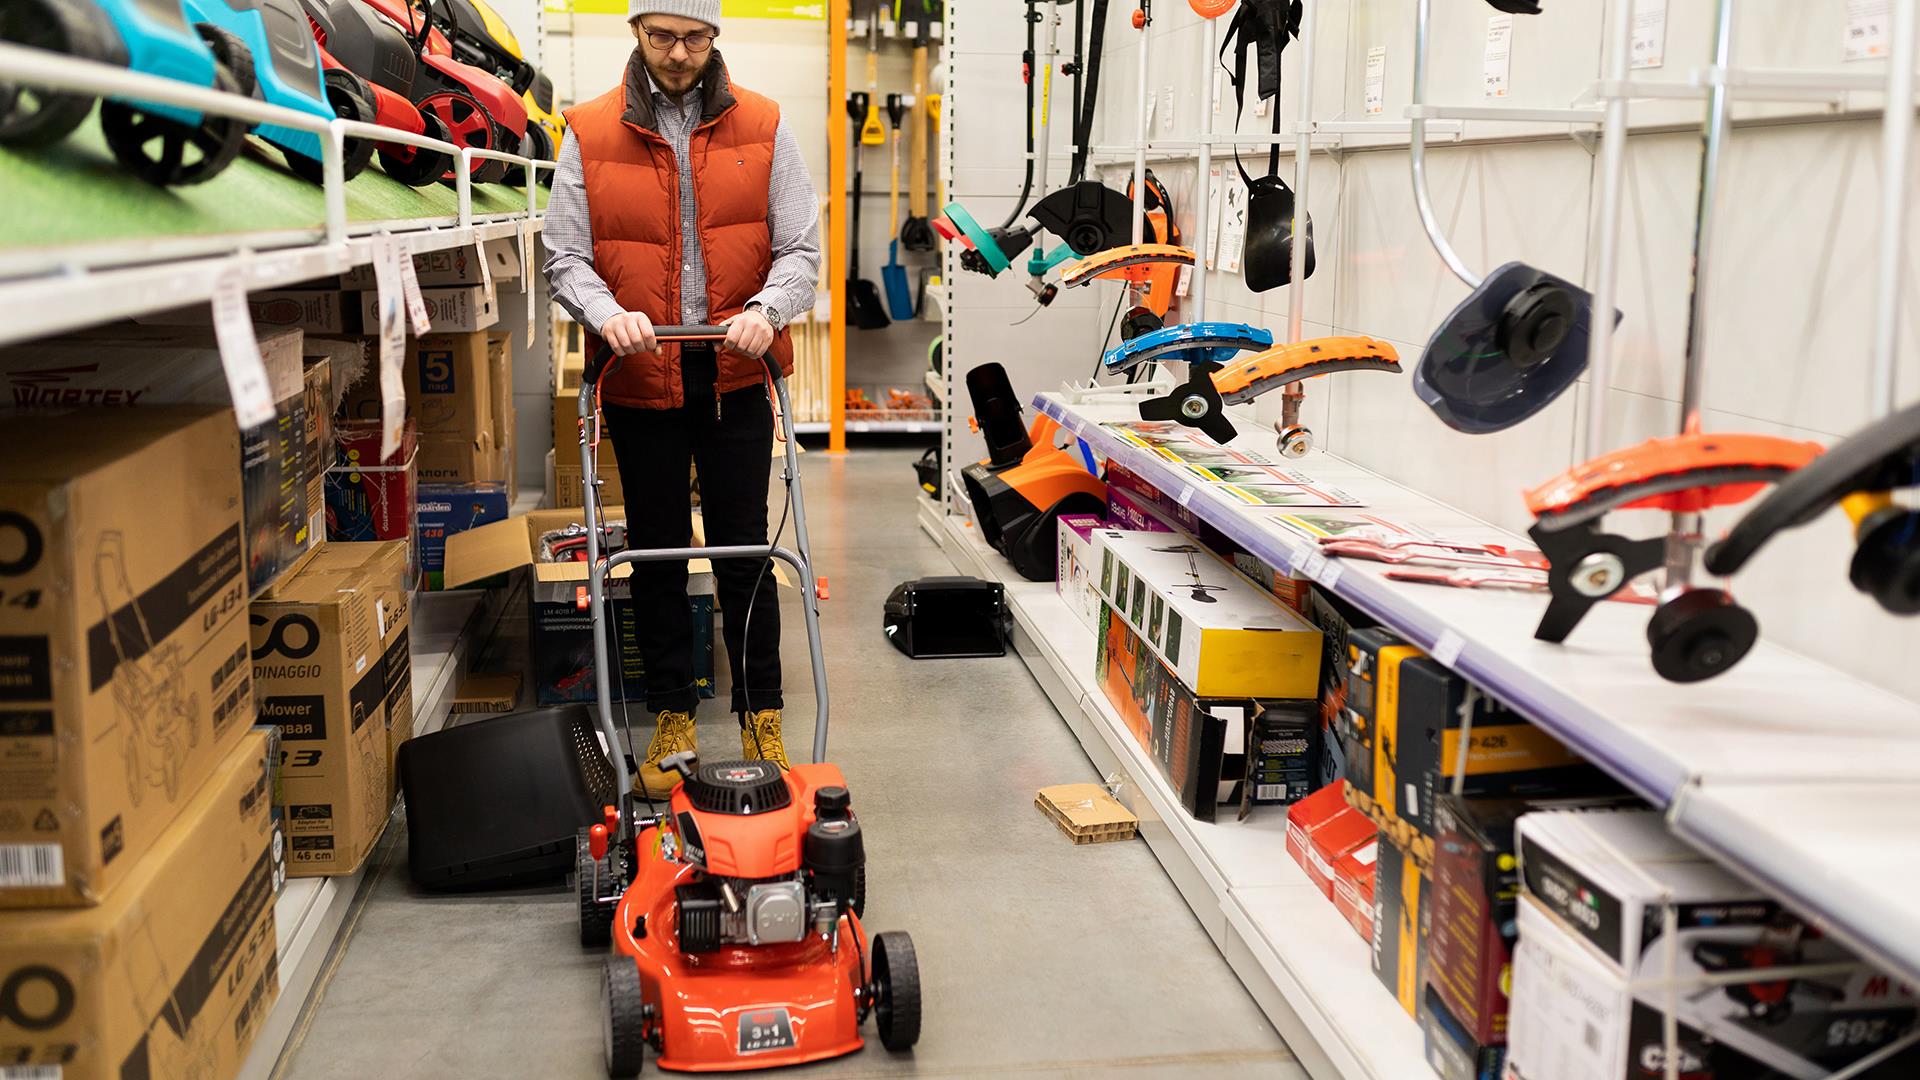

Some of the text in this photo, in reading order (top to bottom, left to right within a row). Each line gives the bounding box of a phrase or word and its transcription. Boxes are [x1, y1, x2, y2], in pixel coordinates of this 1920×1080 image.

[425, 353, 449, 382] 5
[13, 384, 143, 408] WORTEX
[262, 703, 312, 716] Mower
